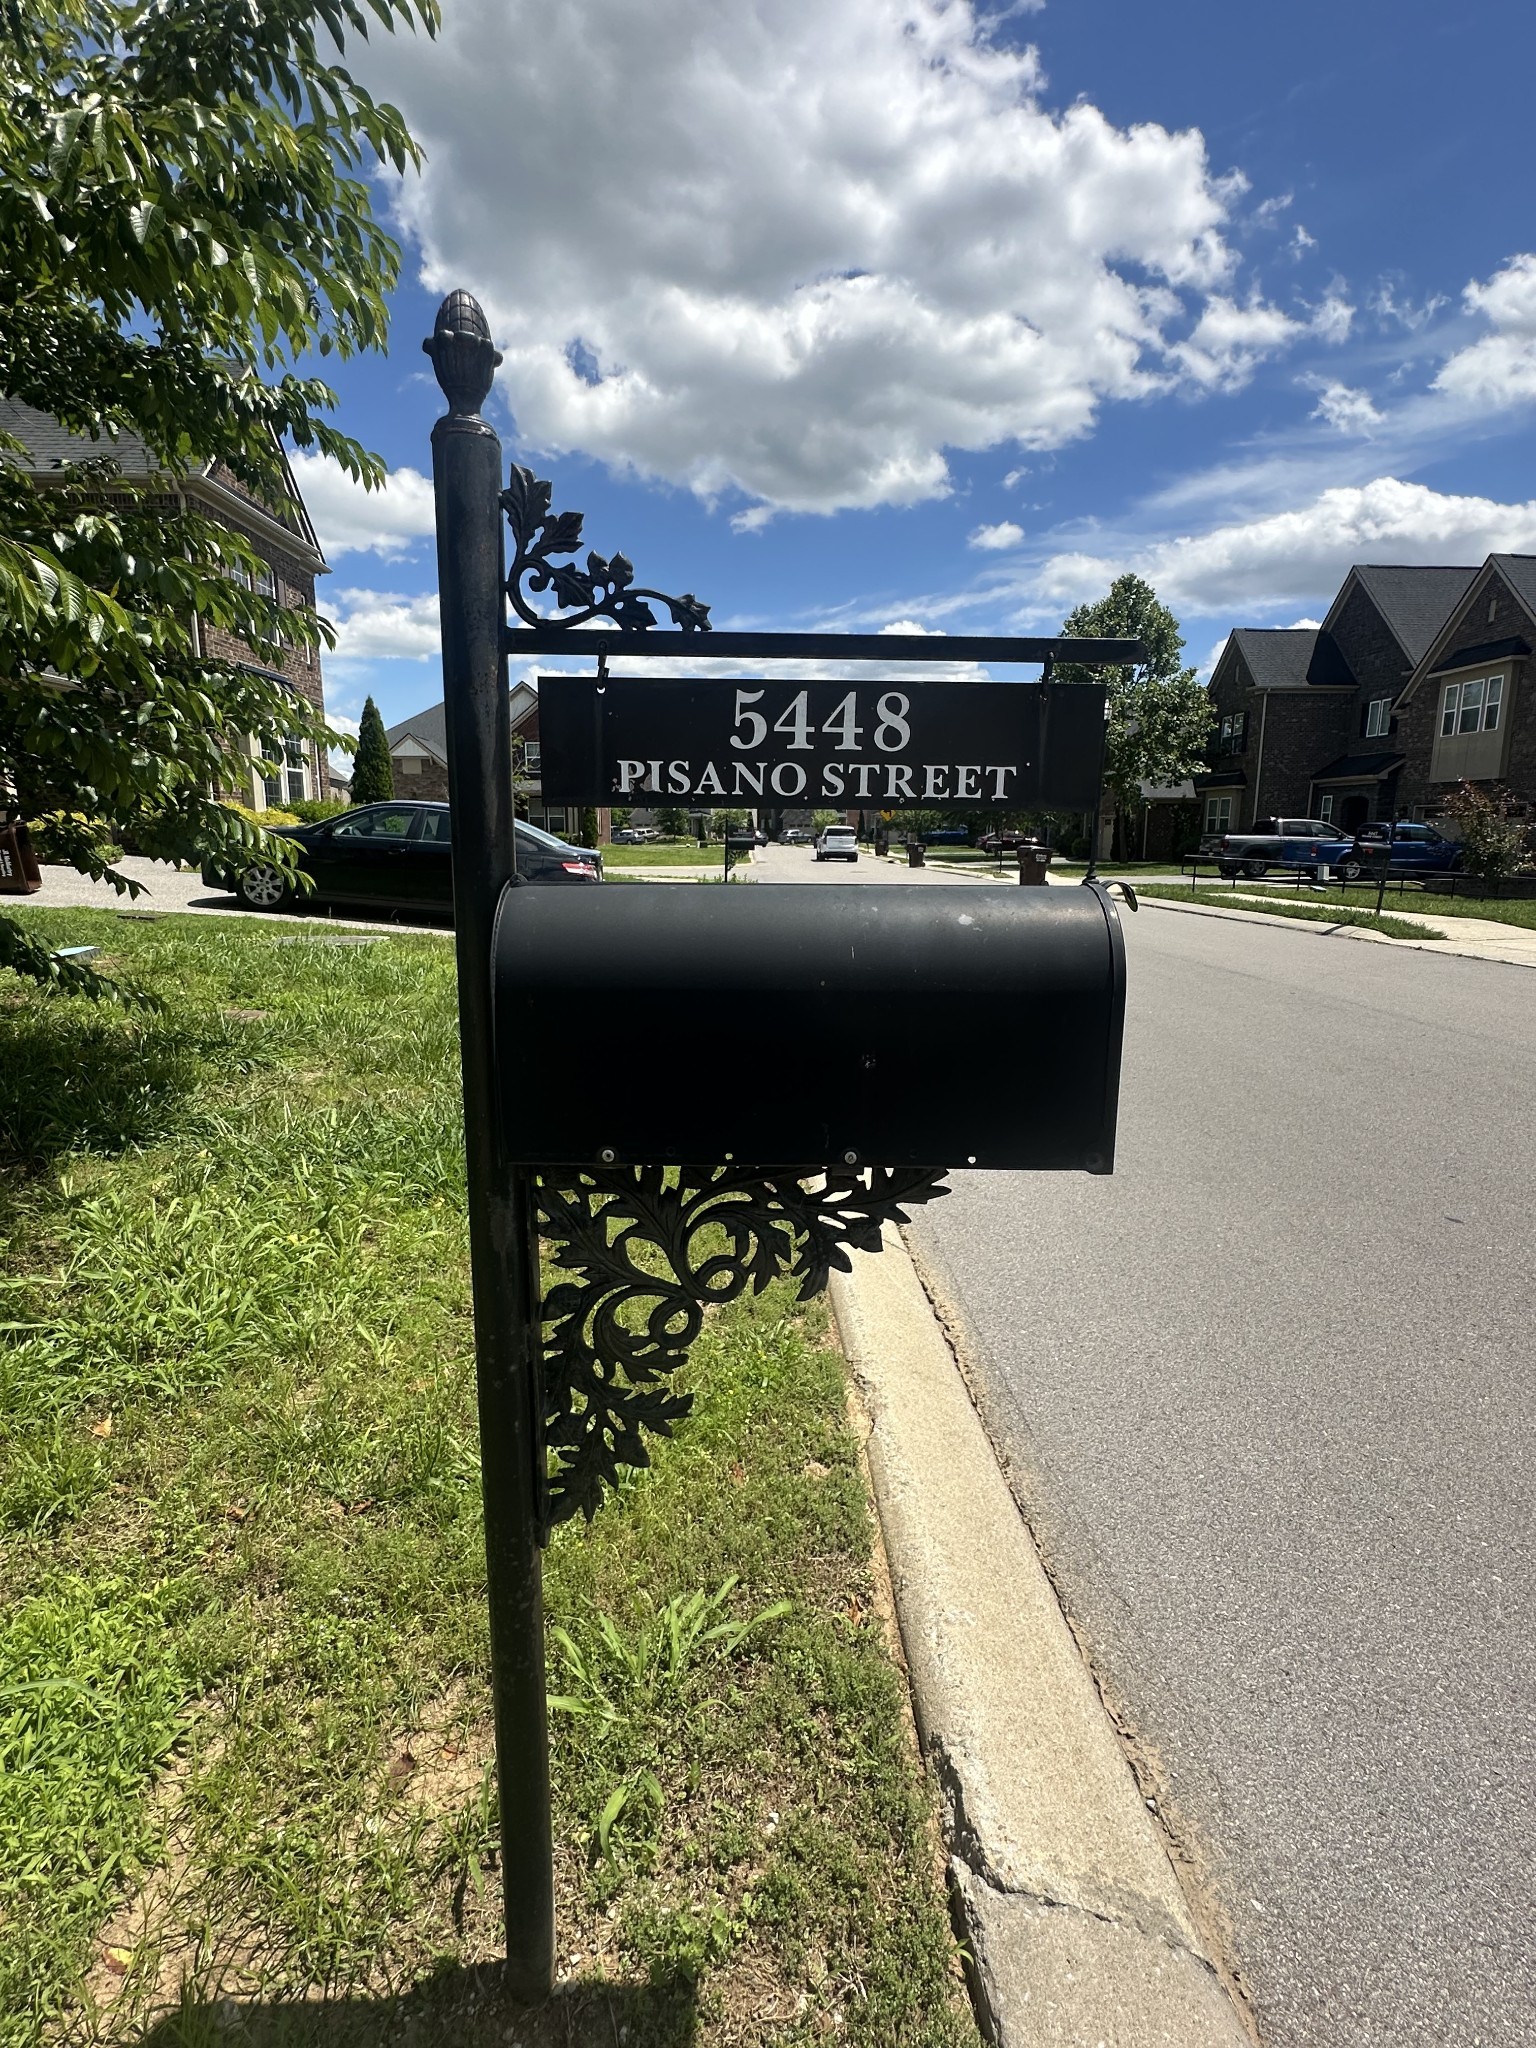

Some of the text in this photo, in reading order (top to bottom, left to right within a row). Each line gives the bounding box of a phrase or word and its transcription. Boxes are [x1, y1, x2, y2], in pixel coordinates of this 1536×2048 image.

[730, 689, 911, 752] 5448
[616, 759, 1017, 799] PISANO STREET
